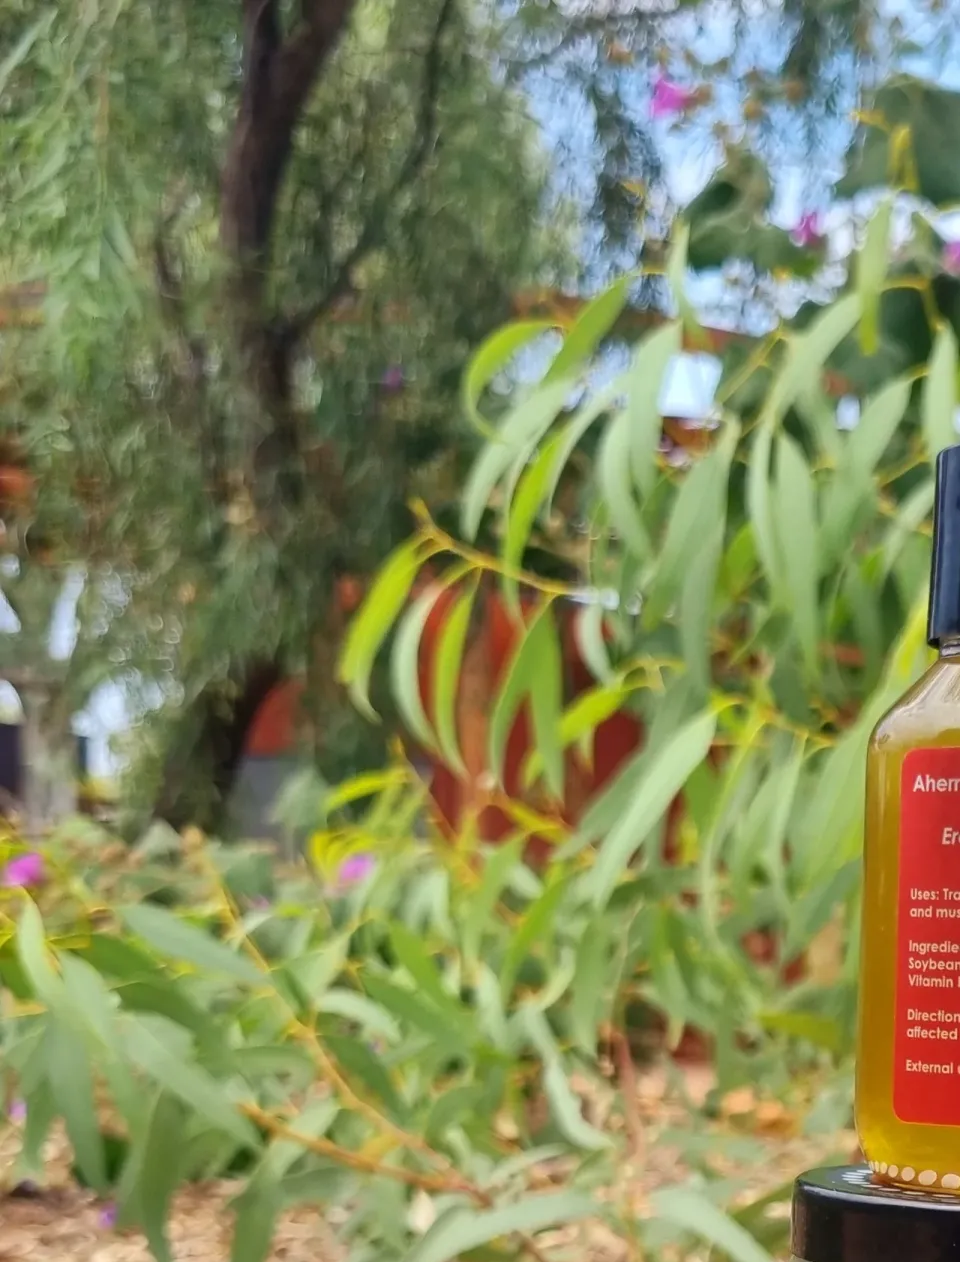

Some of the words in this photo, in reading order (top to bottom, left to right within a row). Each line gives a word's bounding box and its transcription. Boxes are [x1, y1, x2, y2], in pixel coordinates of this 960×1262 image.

[910, 888, 939, 902] Uses:
[909, 905, 933, 919] and
[908, 974, 954, 989] Vitamin
[906, 1026, 958, 1042] affected
[905, 1059, 954, 1075] External
